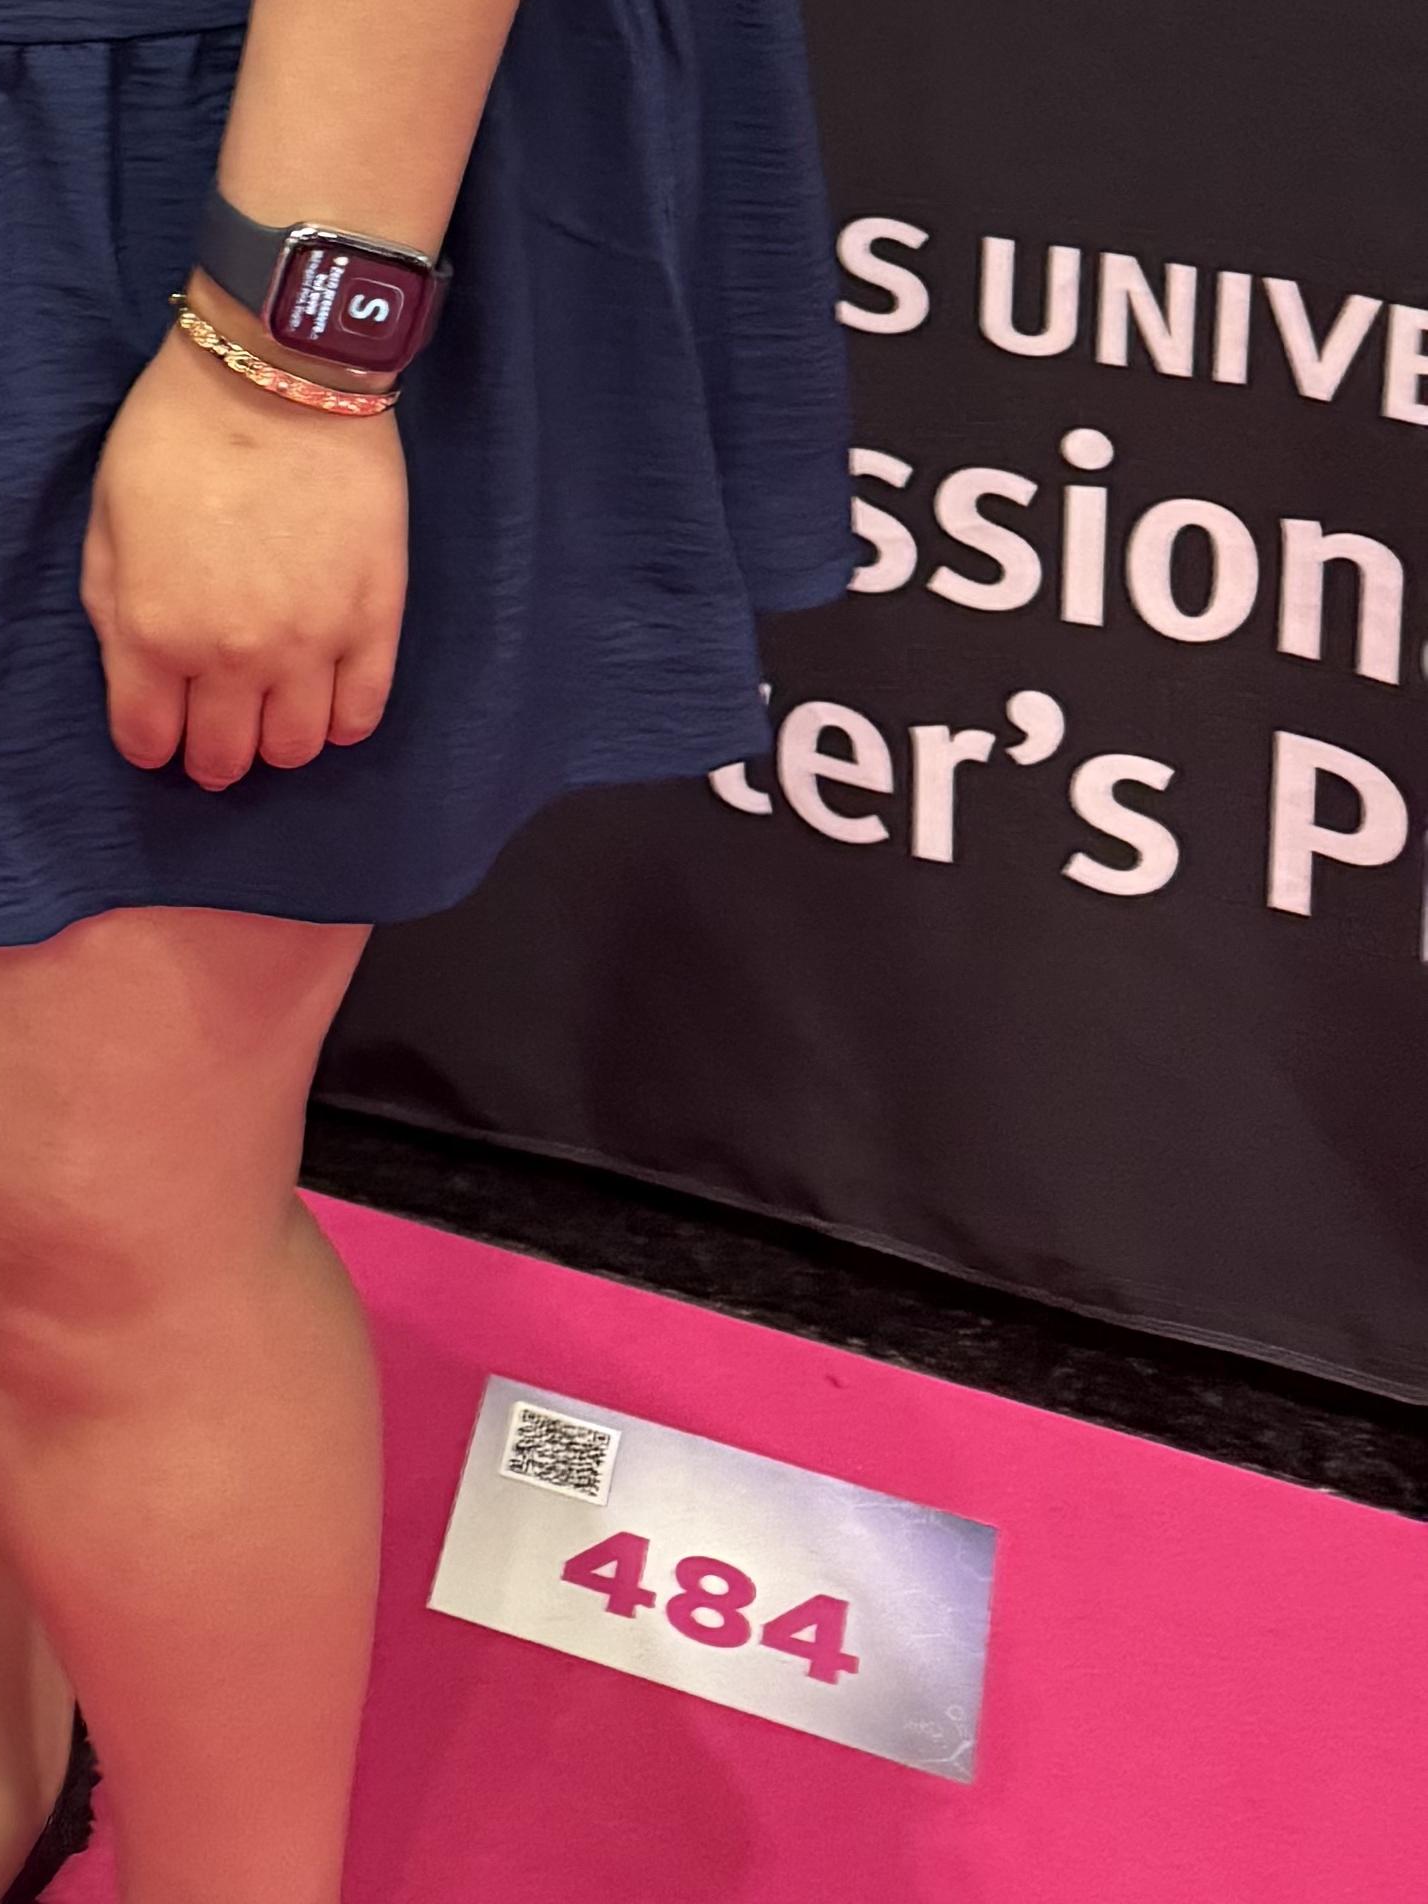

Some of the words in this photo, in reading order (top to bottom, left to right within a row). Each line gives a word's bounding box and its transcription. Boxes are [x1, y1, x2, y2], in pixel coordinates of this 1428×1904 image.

[347, 292, 390, 323] S
[977, 234, 1428, 429] UNIVE
[1265, 728, 1428, 963] P
[560, 1530, 860, 1685] 484
